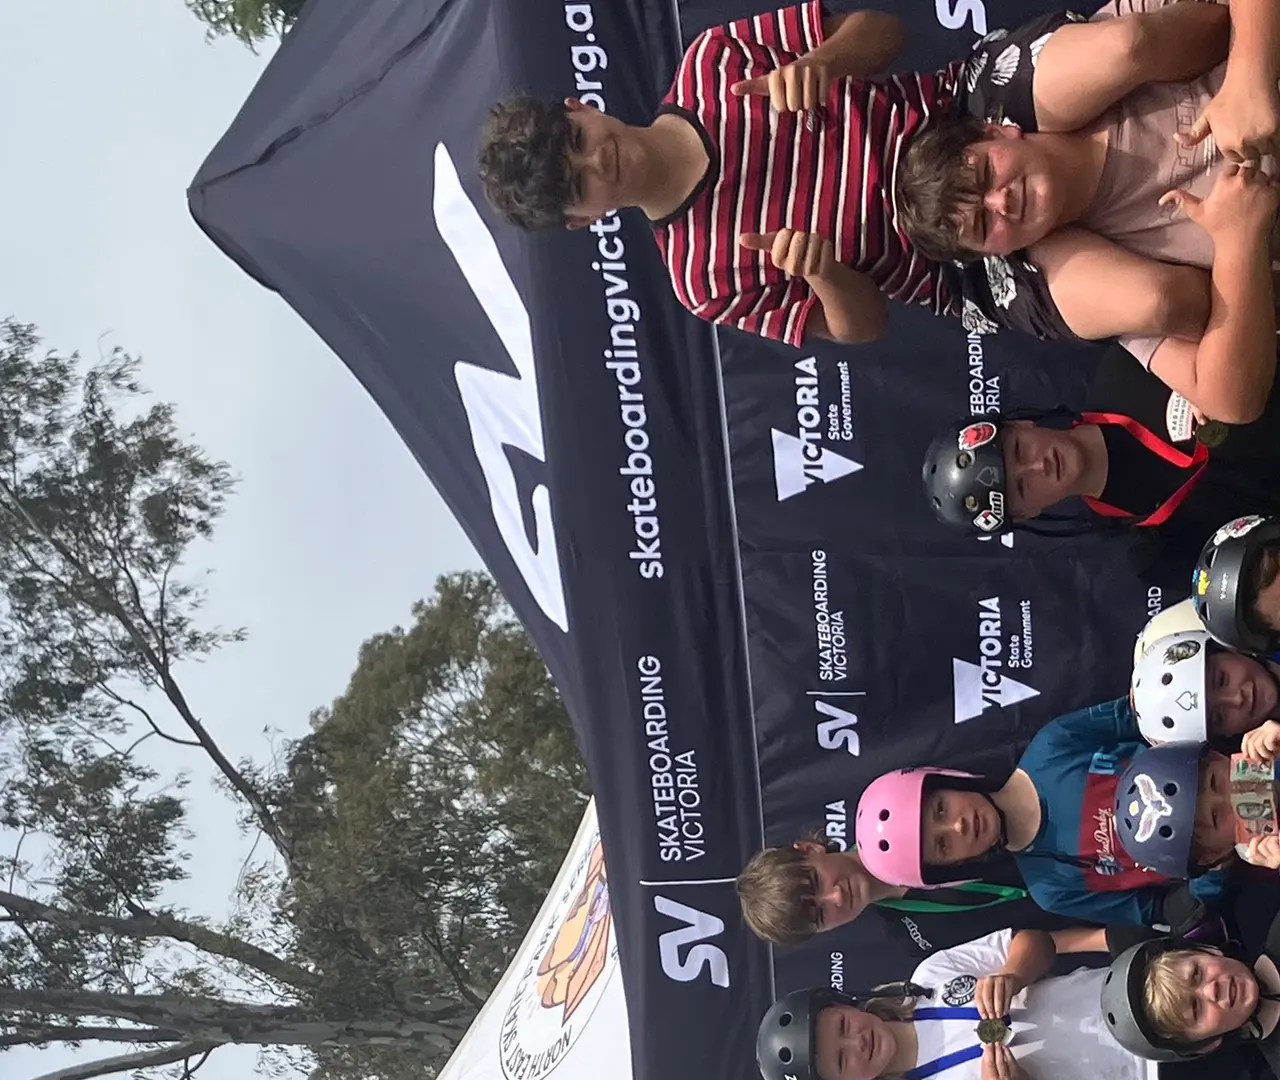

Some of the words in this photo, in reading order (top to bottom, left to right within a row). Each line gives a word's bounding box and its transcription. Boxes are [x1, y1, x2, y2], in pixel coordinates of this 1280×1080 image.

[563, 0, 666, 580] skateboardingvictorg.a
[794, 356, 825, 490] VICTORIA
[826, 403, 841, 441] State
[836, 361, 854, 441] Government
[811, 549, 833, 681] SKATEBOARDING
[830, 610, 848, 681] VICTORIA
[977, 596, 1002, 714] VICTORIA
[1007, 634, 1020, 669] State
[1019, 600, 1033, 669] Government
[637, 654, 682, 862] SKATEBOARDING
[814, 700, 860, 757] SV
[673, 749, 706, 862] VICTORIA
[653, 894, 730, 988] SV
